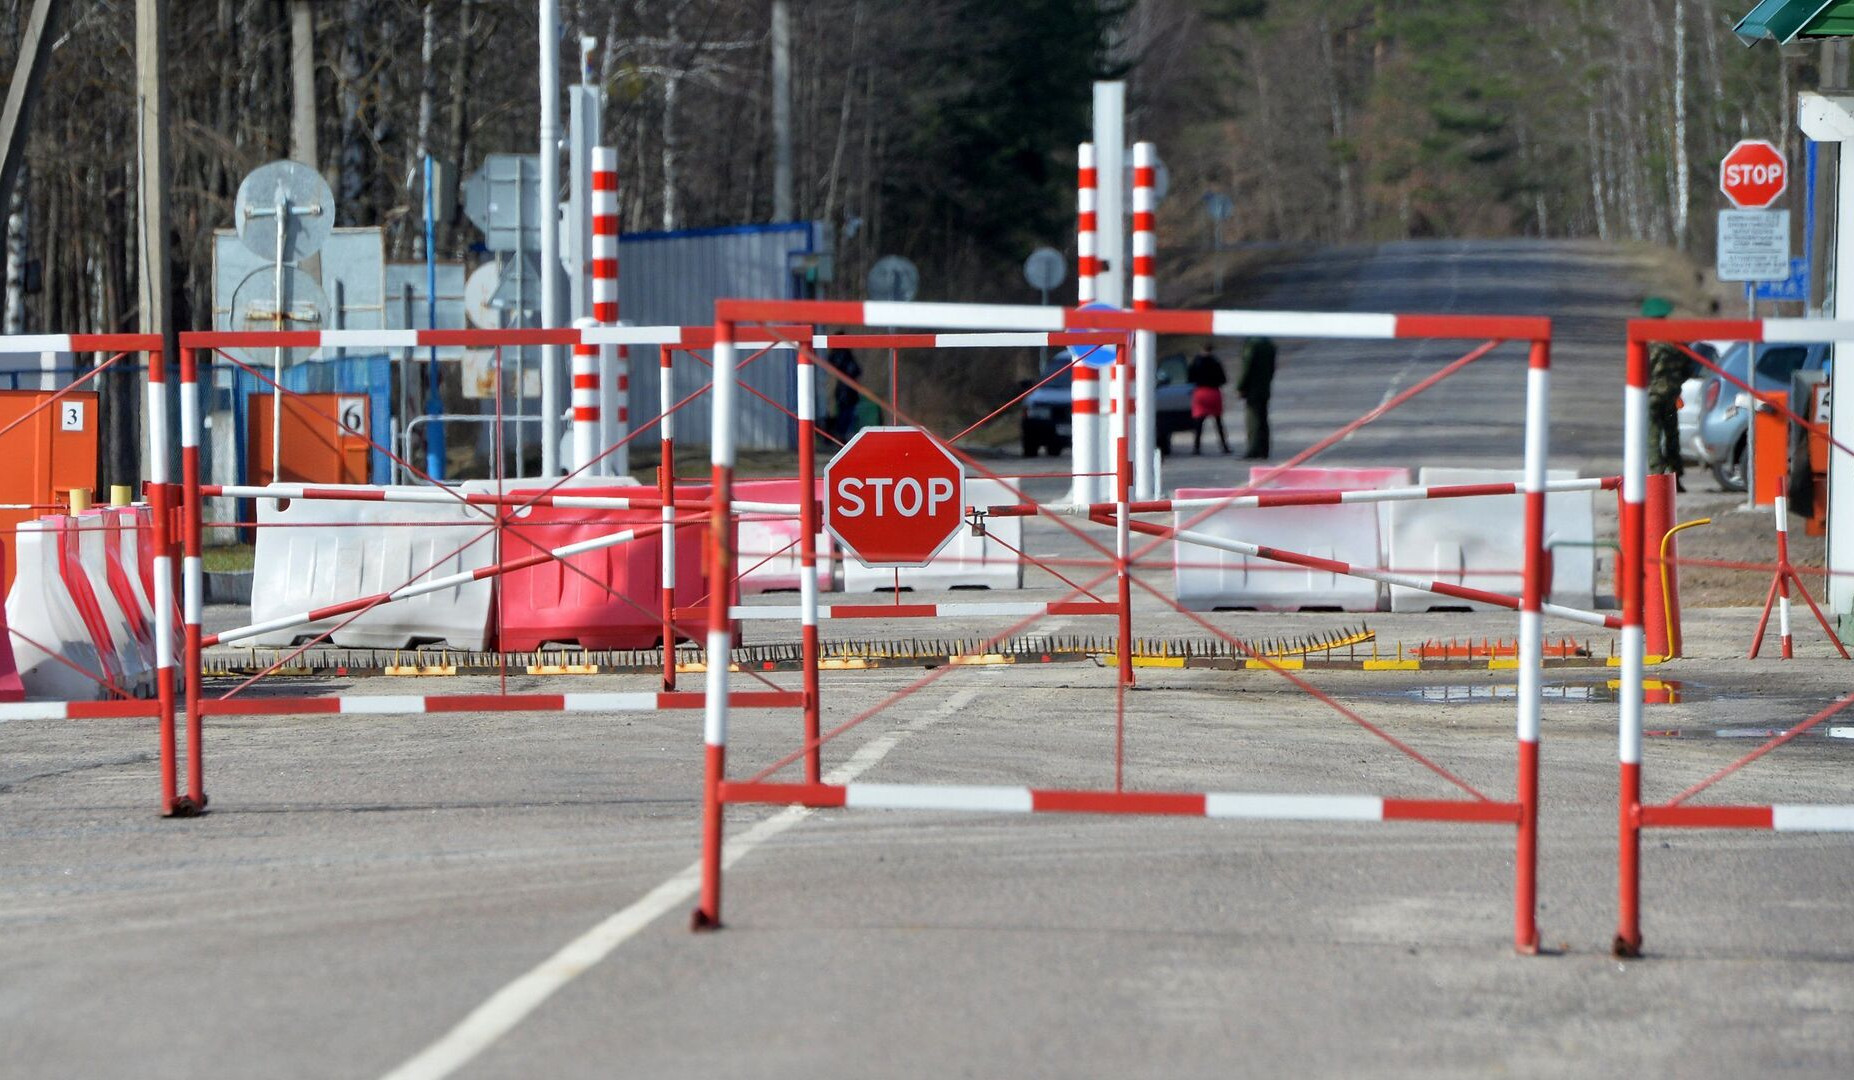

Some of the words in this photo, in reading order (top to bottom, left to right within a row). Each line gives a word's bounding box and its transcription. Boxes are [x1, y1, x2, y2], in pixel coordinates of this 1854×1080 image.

[1727, 164, 1782, 186] STOP
[67, 408, 78, 425] 3
[343, 403, 361, 431] 6
[837, 477, 954, 517] STOP
